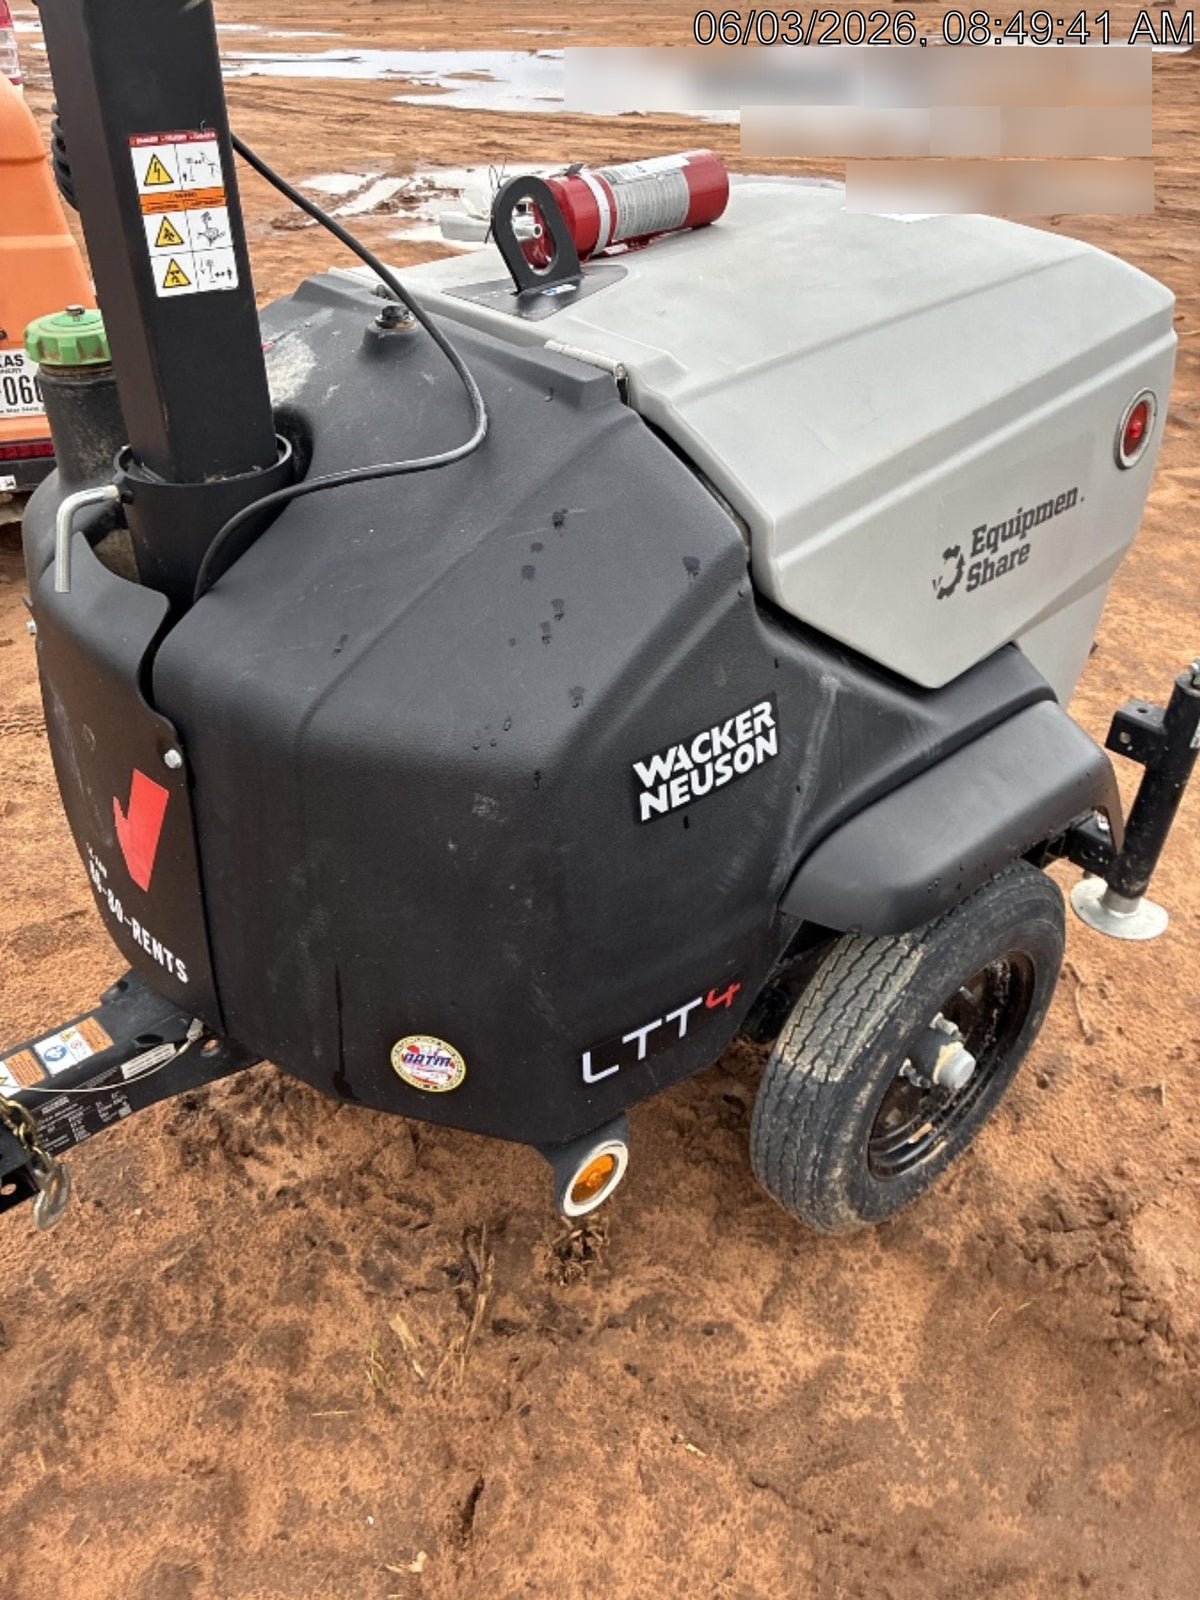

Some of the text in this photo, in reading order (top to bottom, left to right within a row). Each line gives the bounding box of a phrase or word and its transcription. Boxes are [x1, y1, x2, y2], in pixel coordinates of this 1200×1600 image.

[970, 486, 1085, 557] Equipmen
[965, 542, 1031, 593] Share
[632, 701, 776, 788] WACKER
[639, 727, 778, 822] NEUSON
[582, 982, 741, 1084] LTT4
